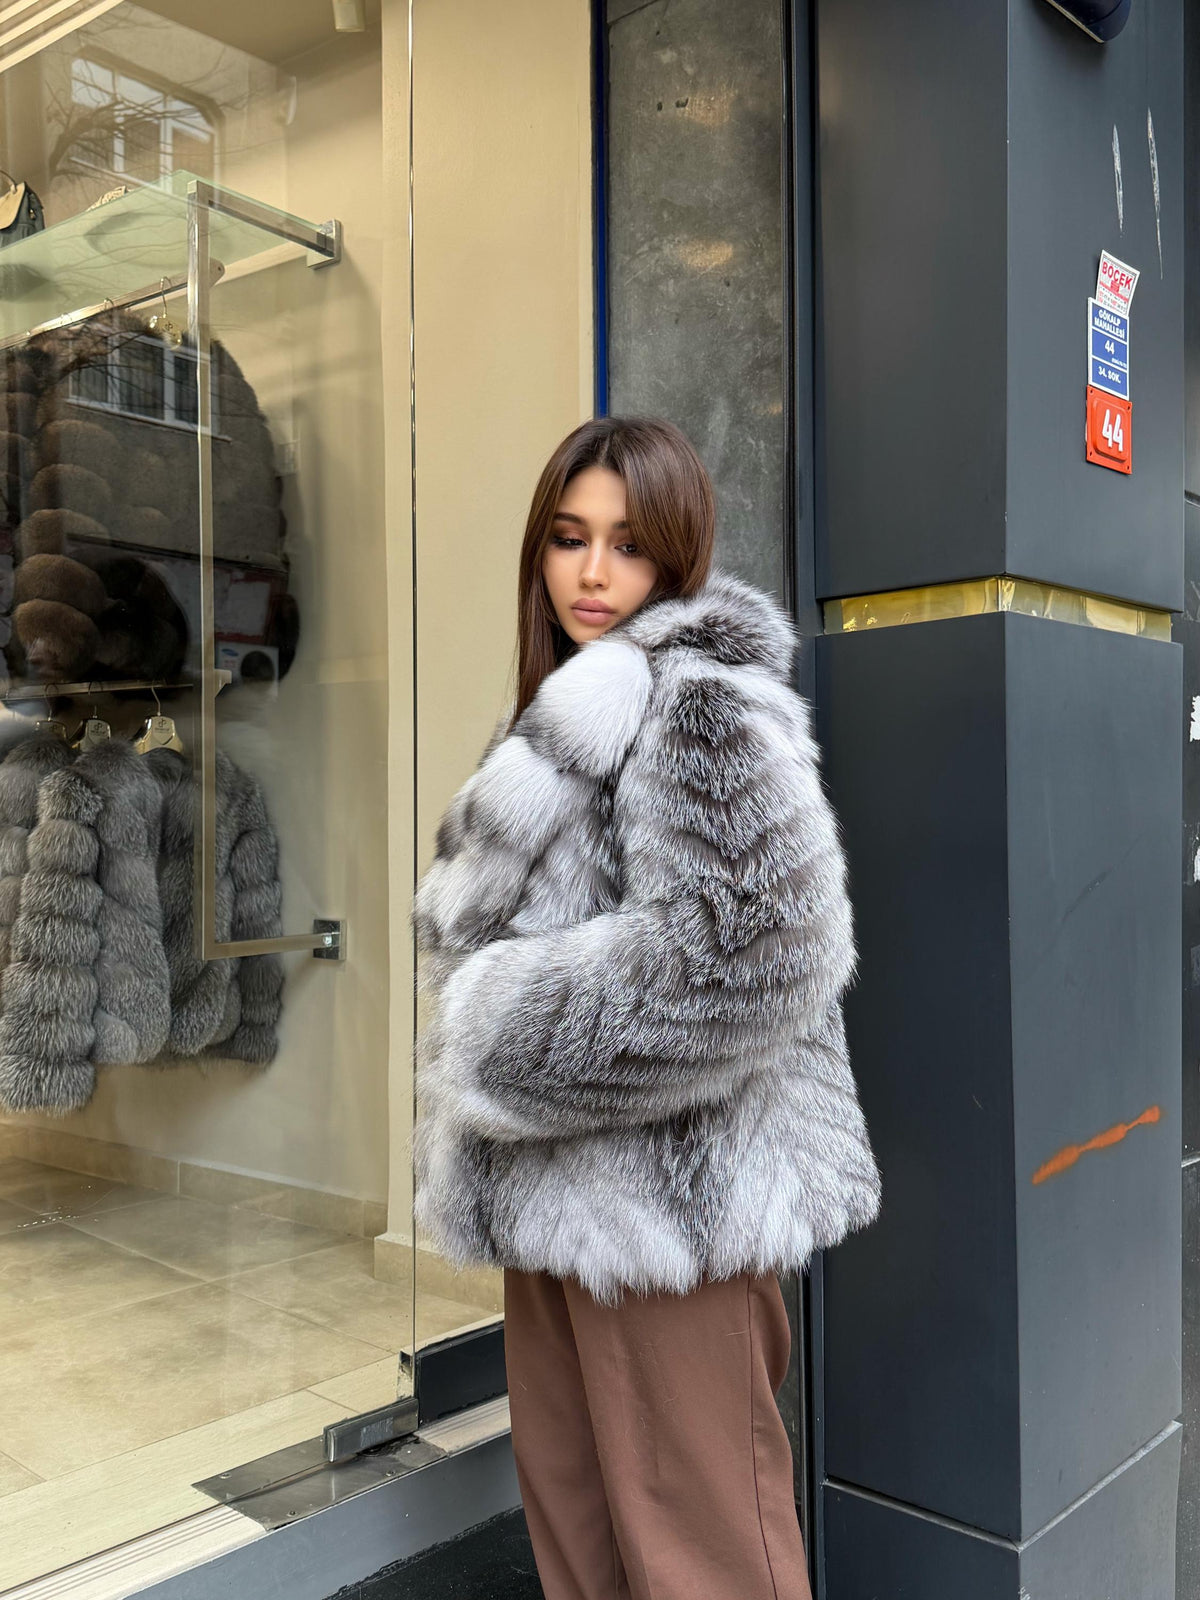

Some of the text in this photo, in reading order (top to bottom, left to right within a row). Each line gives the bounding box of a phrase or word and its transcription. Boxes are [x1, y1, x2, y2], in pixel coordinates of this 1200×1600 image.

[1098, 308, 1121, 326] GÖKALP
[1094, 316, 1125, 339] MAHALLESİ
[1104, 340, 1115, 355] 44
[1102, 409, 1123, 452] 44
